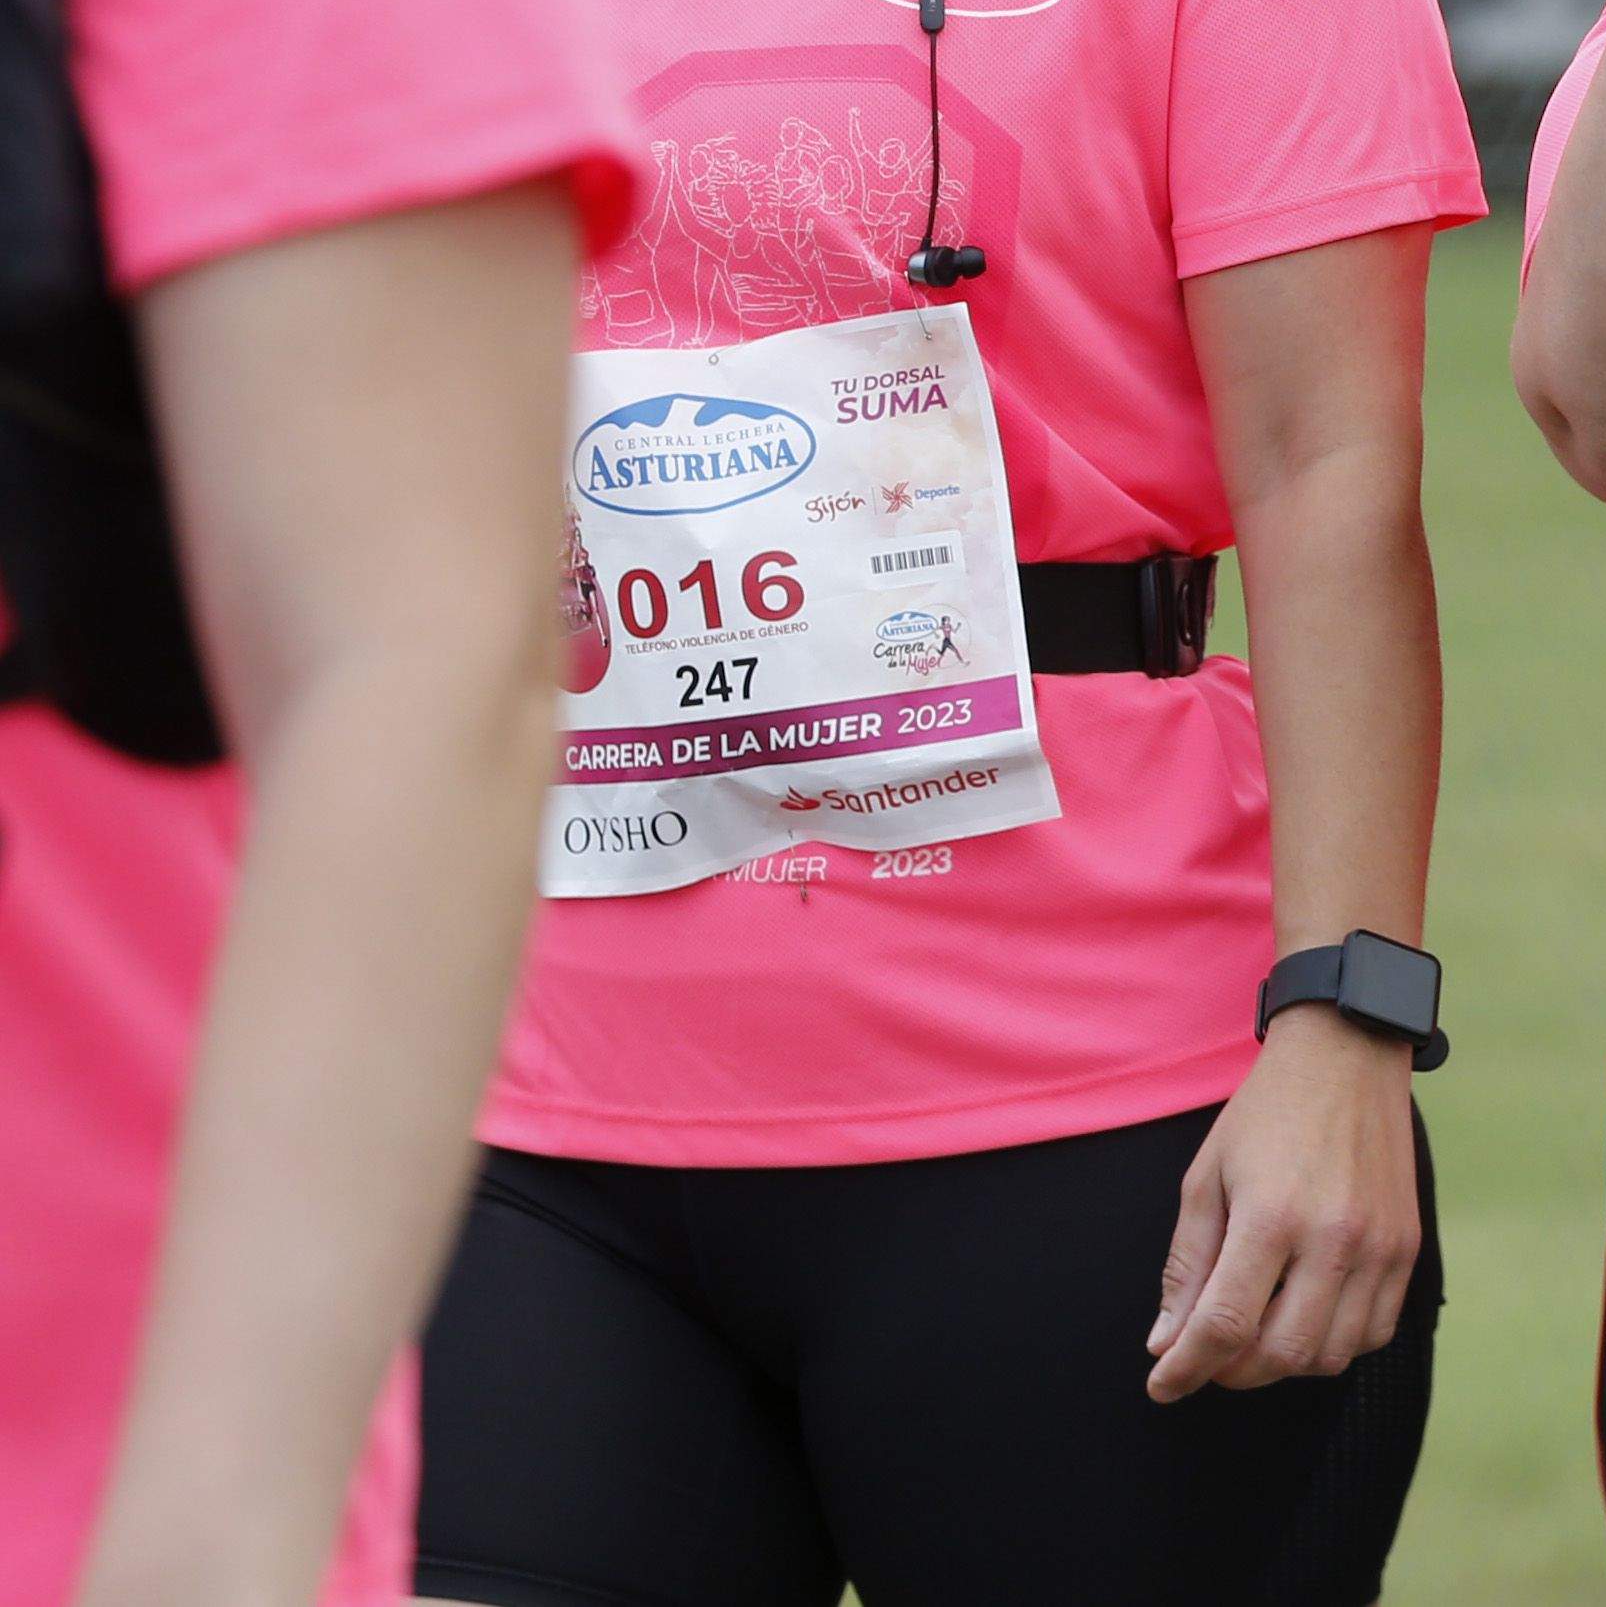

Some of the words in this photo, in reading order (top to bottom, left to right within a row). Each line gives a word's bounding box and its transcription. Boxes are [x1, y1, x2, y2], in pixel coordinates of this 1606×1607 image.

[832, 380, 857, 396] TU
[863, 365, 945, 392] DORSAL
[836, 383, 949, 425] SUMA
[614, 436, 696, 451] CENTRAL
[703, 422, 786, 446] LECHERA
[588, 438, 799, 491] ASTURIANA
[805, 491, 866, 524] gijón
[914, 484, 961, 501] Deporte
[617, 549, 805, 640] 016
[625, 639, 678, 656] TELÉFONO
[679, 631, 738, 649] VIOLENCIA
[739, 629, 756, 640] DE
[758, 621, 809, 639] GÉNERO
[873, 642, 925, 658] Carrera
[906, 654, 941, 675] Mujer
[675, 657, 759, 708] 247
[565, 741, 664, 771] CARRERA
[672, 735, 712, 765] DE
[720, 728, 763, 759] LA
[769, 713, 883, 751] MUJER
[896, 698, 973, 735] 2023
[821, 765, 1001, 815] Santander
[564, 810, 688, 855] OYSHO
[870, 846, 954, 880] 2023
